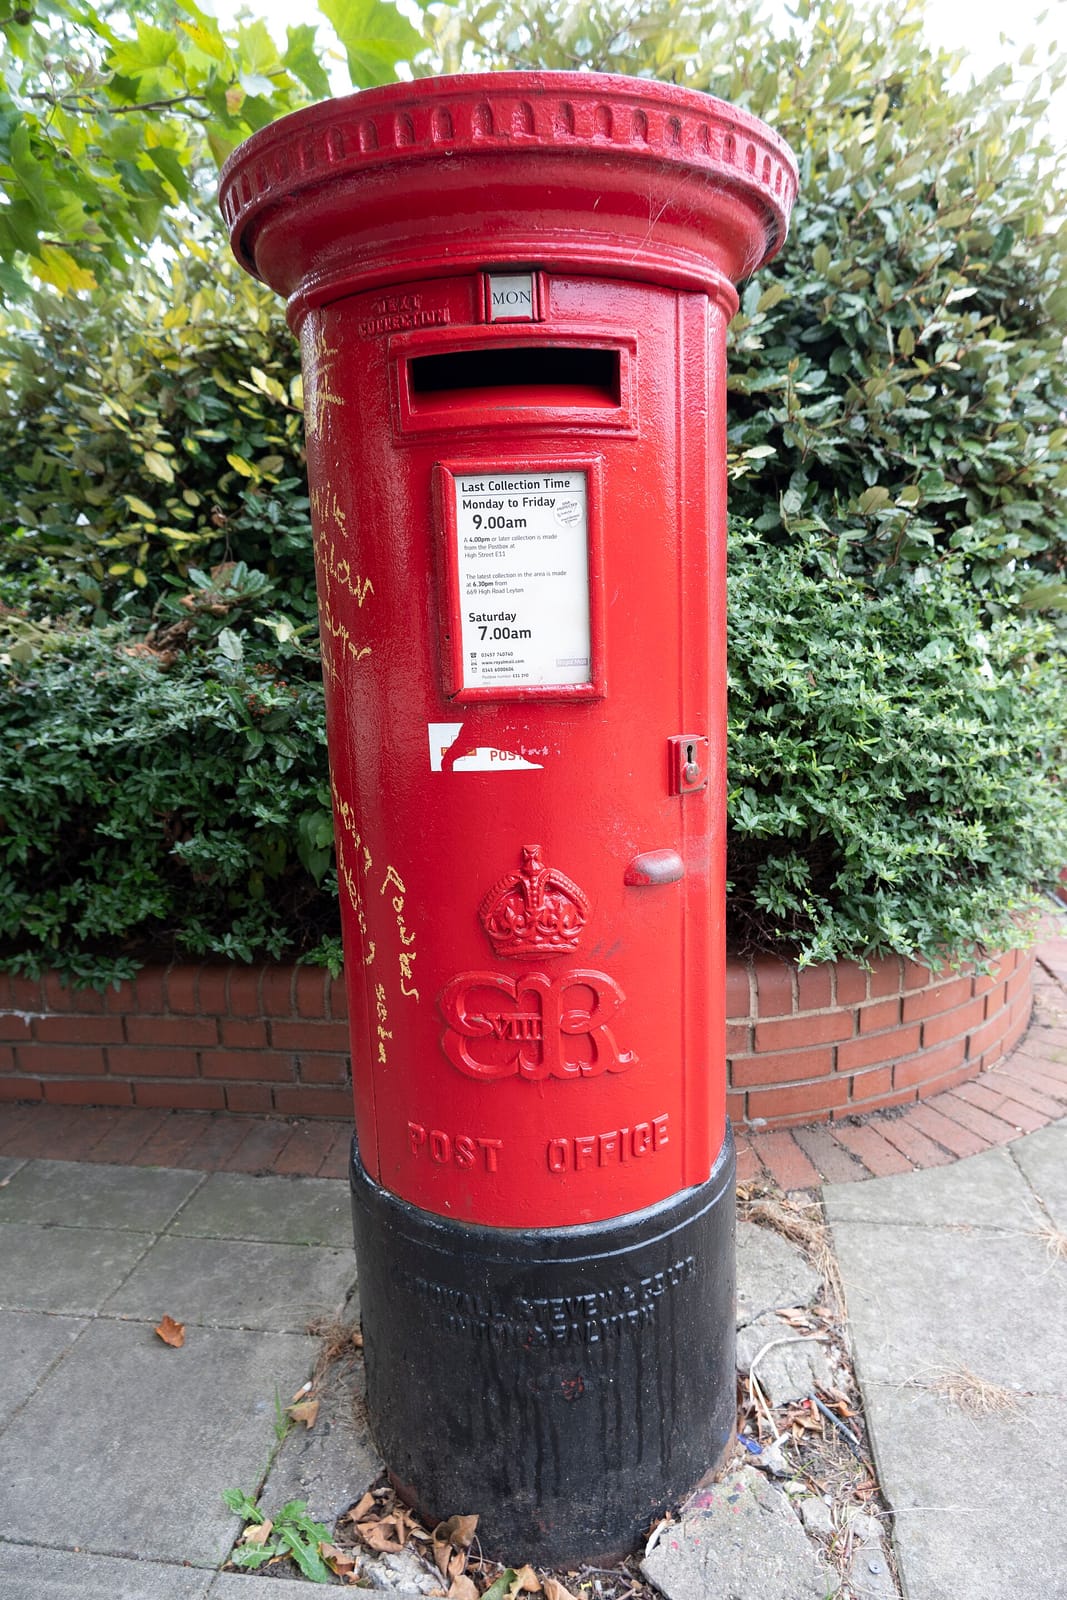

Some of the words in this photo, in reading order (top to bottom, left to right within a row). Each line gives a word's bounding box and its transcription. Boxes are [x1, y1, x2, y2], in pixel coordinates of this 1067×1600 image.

[491, 289, 532, 306] MON
[461, 481, 485, 492] Last
[488, 479, 541, 491] Collection
[543, 478, 571, 489] Time
[462, 499, 504, 511] Monday
[508, 499, 519, 508] to
[522, 497, 556, 510] Friday
[472, 514, 527, 530] 9.00am
[469, 536, 491, 544] 4.00pm
[511, 534, 536, 542] collection
[472, 580, 494, 588] 6.30pm
[468, 611, 517, 623] Saturday
[478, 626, 532, 641] 7.00am
[407, 1120, 503, 1173] POST
[547, 1112, 670, 1173] OFFICE
[518, 1292, 613, 1323] STEVEN
